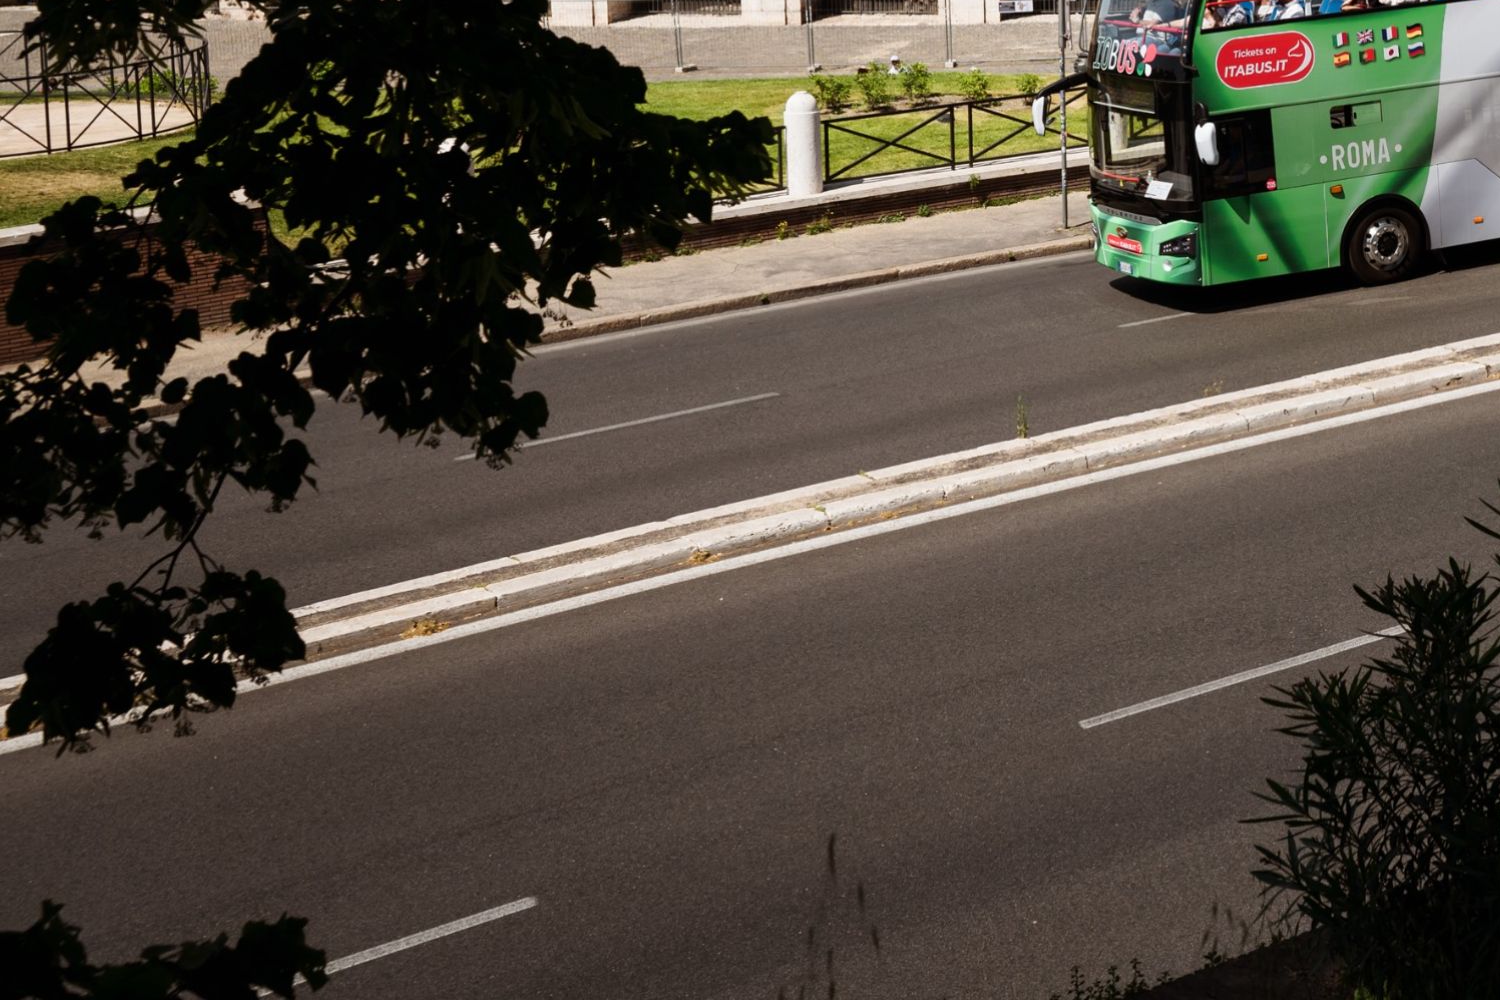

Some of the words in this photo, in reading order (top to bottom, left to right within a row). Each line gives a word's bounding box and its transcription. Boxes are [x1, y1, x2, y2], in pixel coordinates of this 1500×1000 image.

[1092, 35, 1139, 75] IOBUS
[1233, 47, 1264, 59] Tickets
[1265, 47, 1277, 55] on
[1223, 59, 1289, 78] ITABUS.IT
